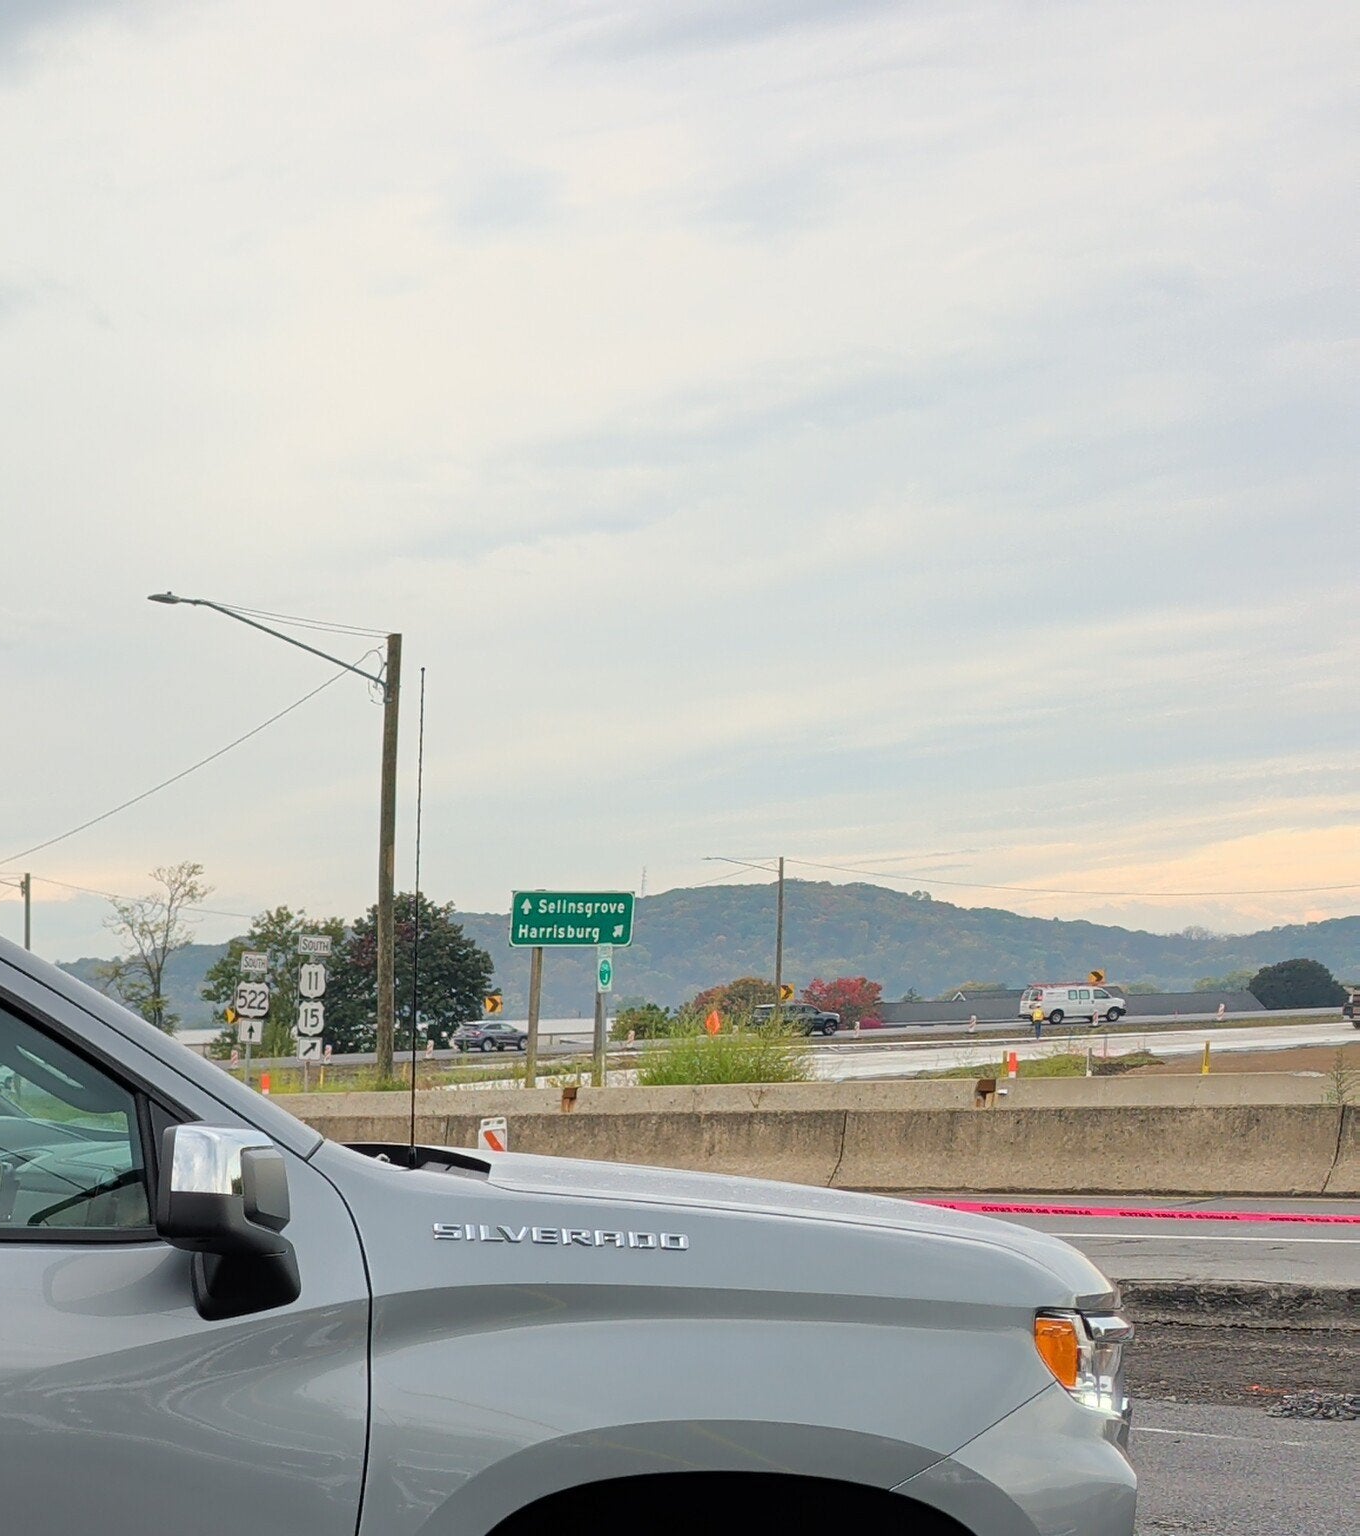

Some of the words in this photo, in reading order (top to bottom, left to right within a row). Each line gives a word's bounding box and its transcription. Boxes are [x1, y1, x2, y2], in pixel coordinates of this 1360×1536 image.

[538, 899, 625, 917] Selinsgrove
[518, 924, 600, 942] Harrisburg
[302, 939, 329, 951] SOUTH
[244, 956, 266, 968] SOUTH
[308, 971, 318, 990] 11
[237, 989, 267, 1010] 522
[304, 1009, 319, 1028] 15
[433, 1222, 690, 1251] SILVERADO
